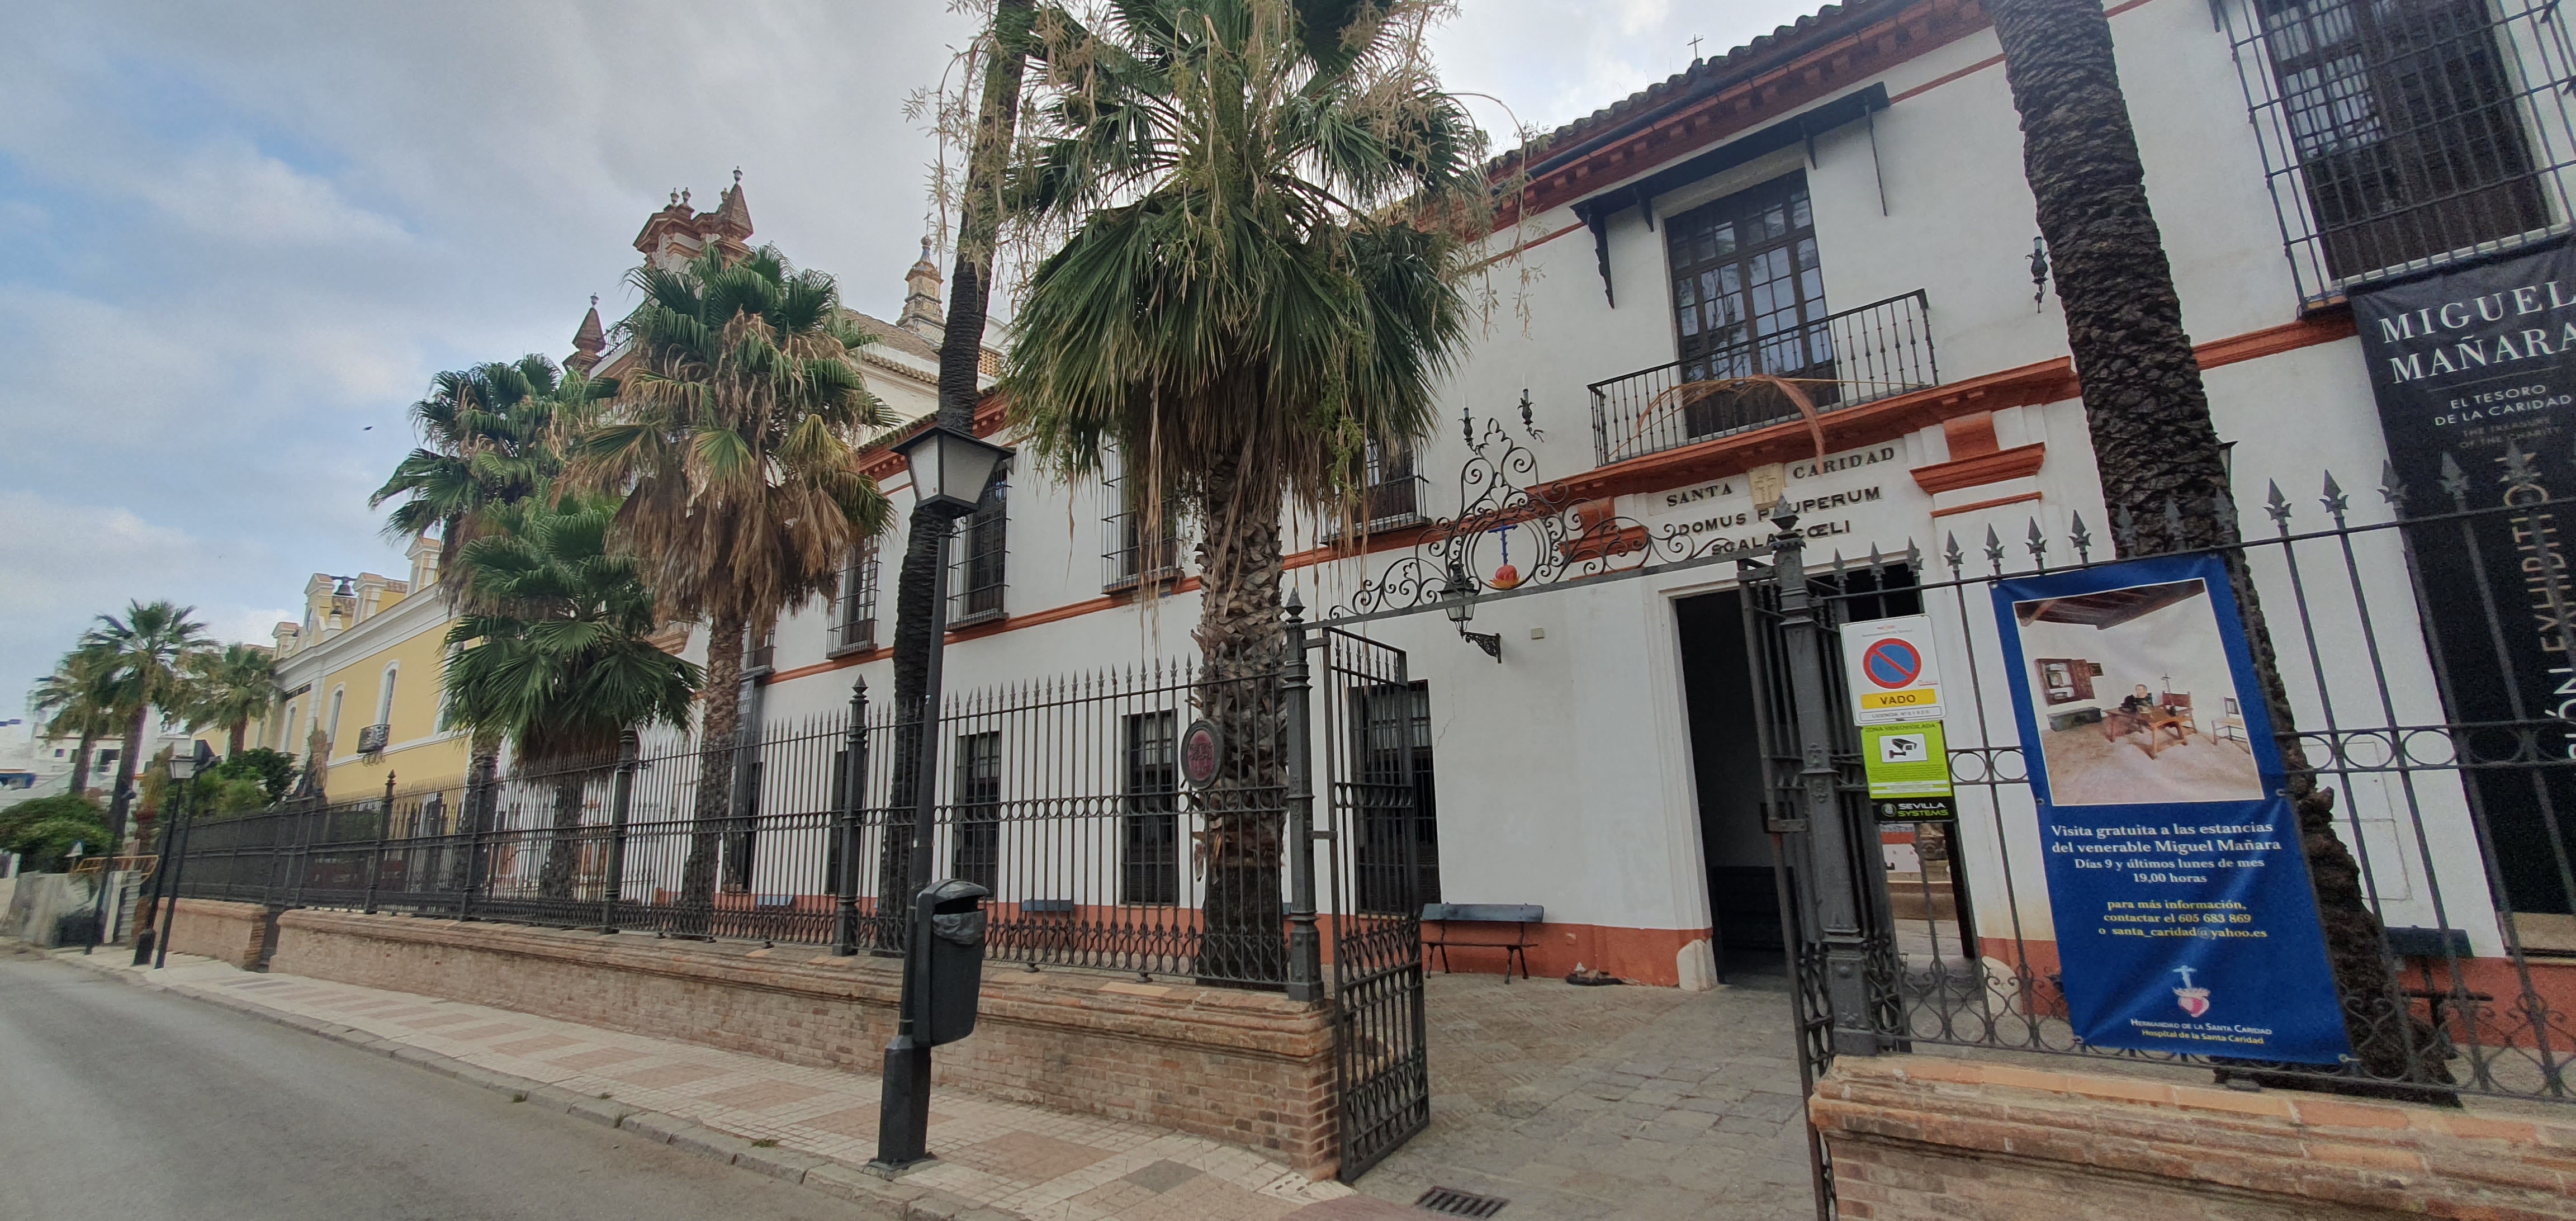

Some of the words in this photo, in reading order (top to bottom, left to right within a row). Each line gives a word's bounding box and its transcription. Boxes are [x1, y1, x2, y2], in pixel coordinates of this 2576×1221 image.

[2379, 281, 2576, 344] MIGUEL
[2388, 322, 2576, 384] MAÑARA
[2450, 397, 2469, 409] EL
[2473, 385, 2546, 405] TESORO
[2435, 414, 2457, 426] DE
[2463, 410, 2483, 421] LA
[2488, 395, 2572, 416] CARIDAD
[1666, 483, 1733, 507] SANTA
[1792, 447, 1895, 479] CARIDAD
[1678, 513, 1747, 536] DOMUS
[1758, 486, 1882, 522] PUPERUM
[1712, 534, 1777, 555] SCALA
[1879, 694, 1916, 705] VADO
[2051, 825, 2093, 836] Visita
[2096, 824, 2157, 839] gratuita
[2173, 823, 2196, 835] las
[2199, 822, 2274, 834] estancias
[2052, 841, 2074, 853] del
[2077, 841, 2152, 853] venerable
[2155, 840, 2214, 855] Miguel
[2217, 839, 2282, 851] Mañara
[2075, 859, 2103, 869] Días
[2105, 859, 2113, 868] 9
[2115, 862, 2123, 872] y
[2127, 858, 2175, 869] últimos
[2177, 858, 2215, 868] lunes
[2218, 858, 2234, 868] de
[2133, 873, 2167, 883] 19,00
[2169, 873, 2208, 883] horas
[2107, 901, 2135, 911] para
[2137, 900, 2162, 908] más
[2165, 899, 2247, 910] información,
[2103, 914, 2161, 922] contactar
[2163, 913, 2176, 922] el
[2178, 914, 2200, 922] 605
[2203, 913, 2226, 922] 683
[2228, 914, 2252, 922] 869
[2111, 927, 2268, 940] santa_caridad@yahoo.es
[2142, 1029, 2177, 1038] Hospital
[2228, 1034, 2265, 1044] Caridad
